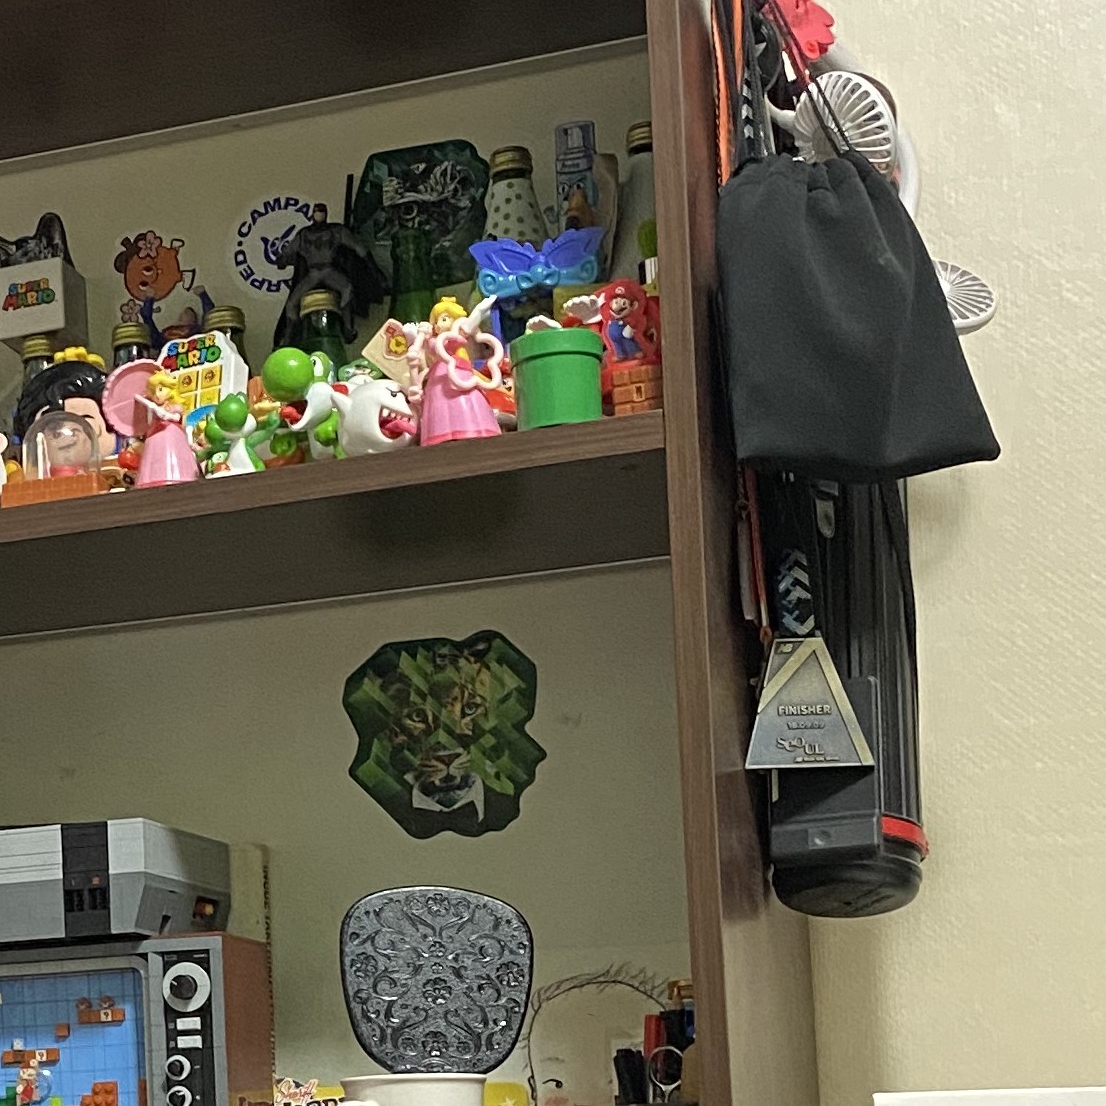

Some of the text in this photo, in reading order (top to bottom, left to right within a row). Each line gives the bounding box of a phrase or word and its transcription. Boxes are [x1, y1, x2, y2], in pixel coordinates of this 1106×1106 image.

[8, 278, 49, 295] SUPER
[2, 288, 56, 311] MARIO
[167, 334, 216, 356] SUPER
[161, 345, 221, 372] MARIO
[778, 704, 832, 716] FINISHER
